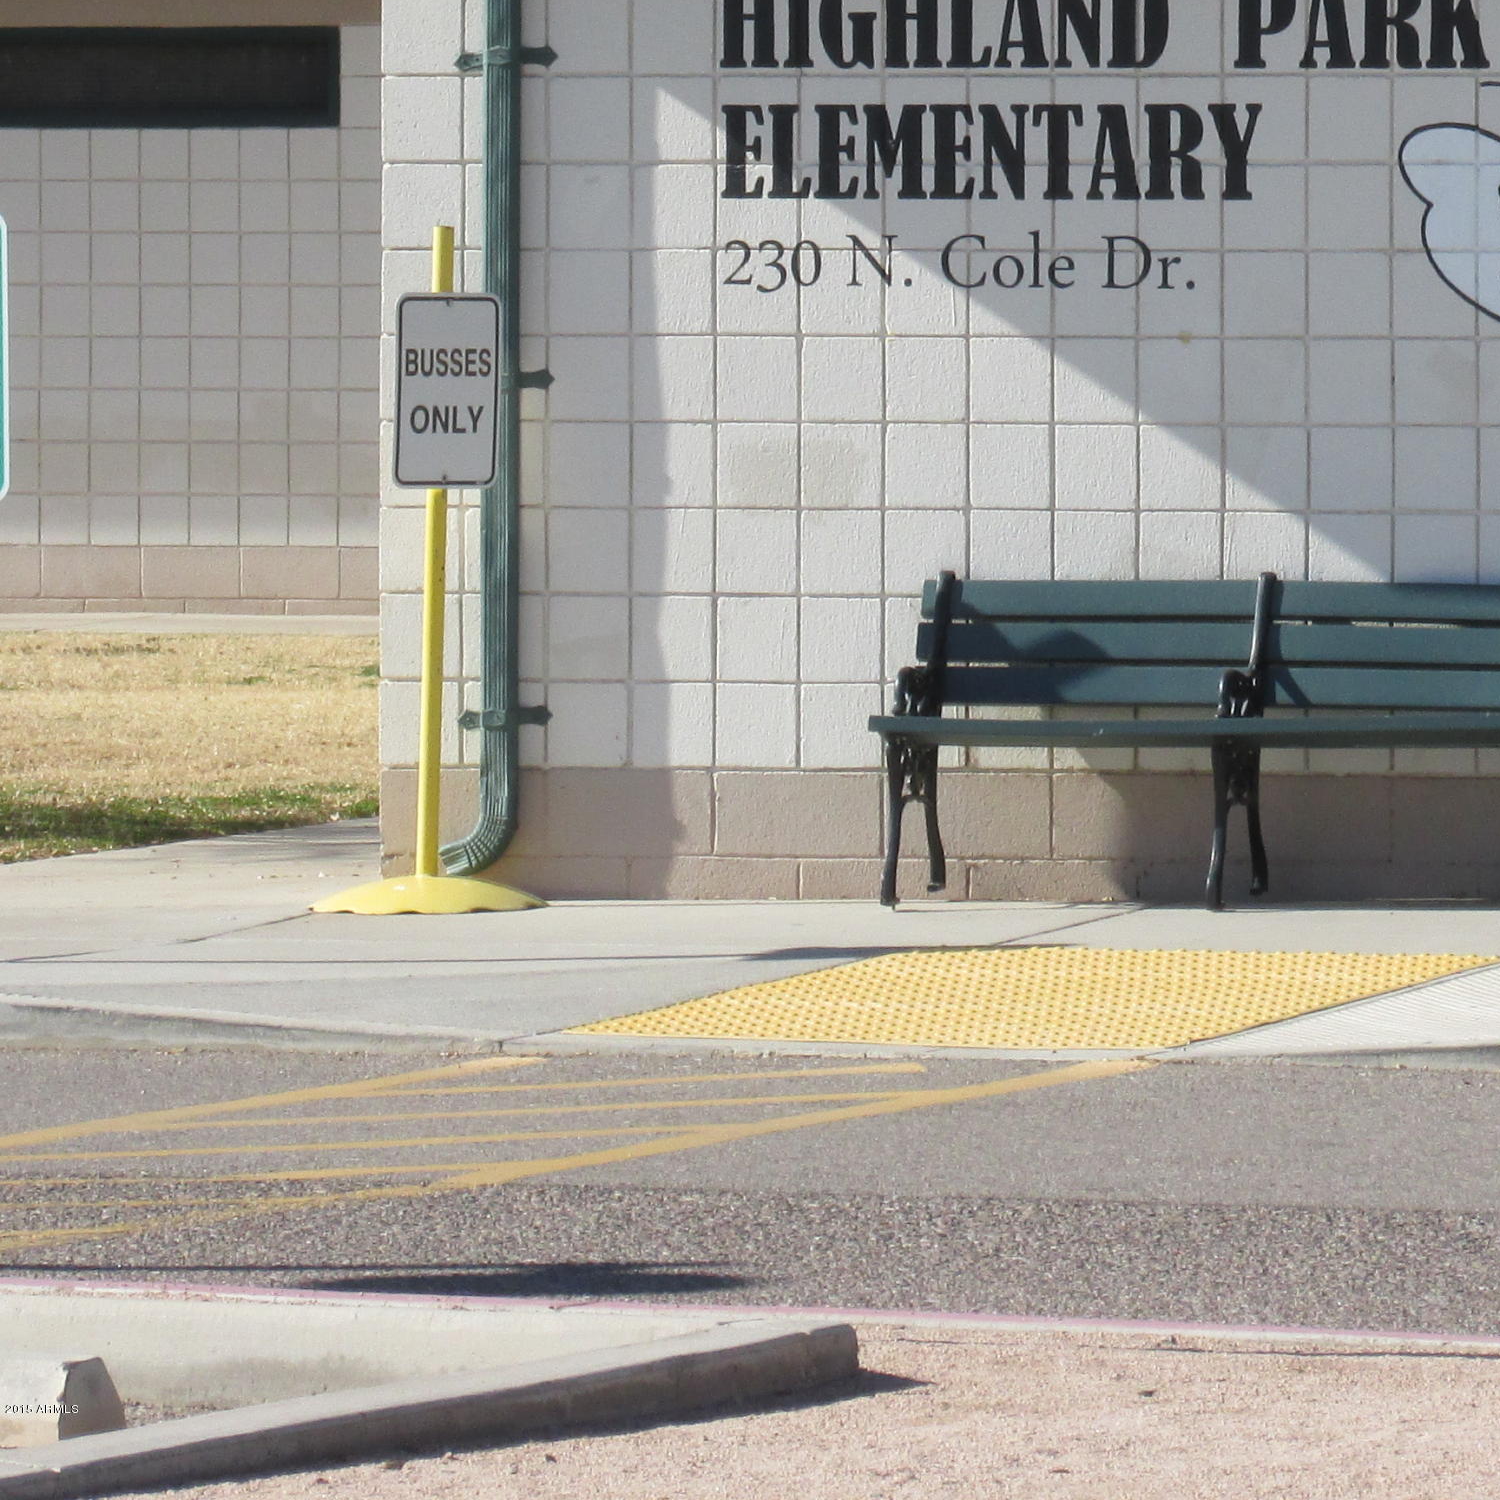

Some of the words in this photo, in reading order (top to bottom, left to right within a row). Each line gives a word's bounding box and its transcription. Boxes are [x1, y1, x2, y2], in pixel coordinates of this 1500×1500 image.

[720, 103, 1263, 201] ELEMENTARY
[722, 238, 822, 293] 230
[845, 233, 914, 289] N.
[940, 231, 1077, 289] Cole
[1100, 234, 1197, 290] Dr.
[405, 348, 491, 376] BUSSES
[410, 405, 484, 433] ONLY
